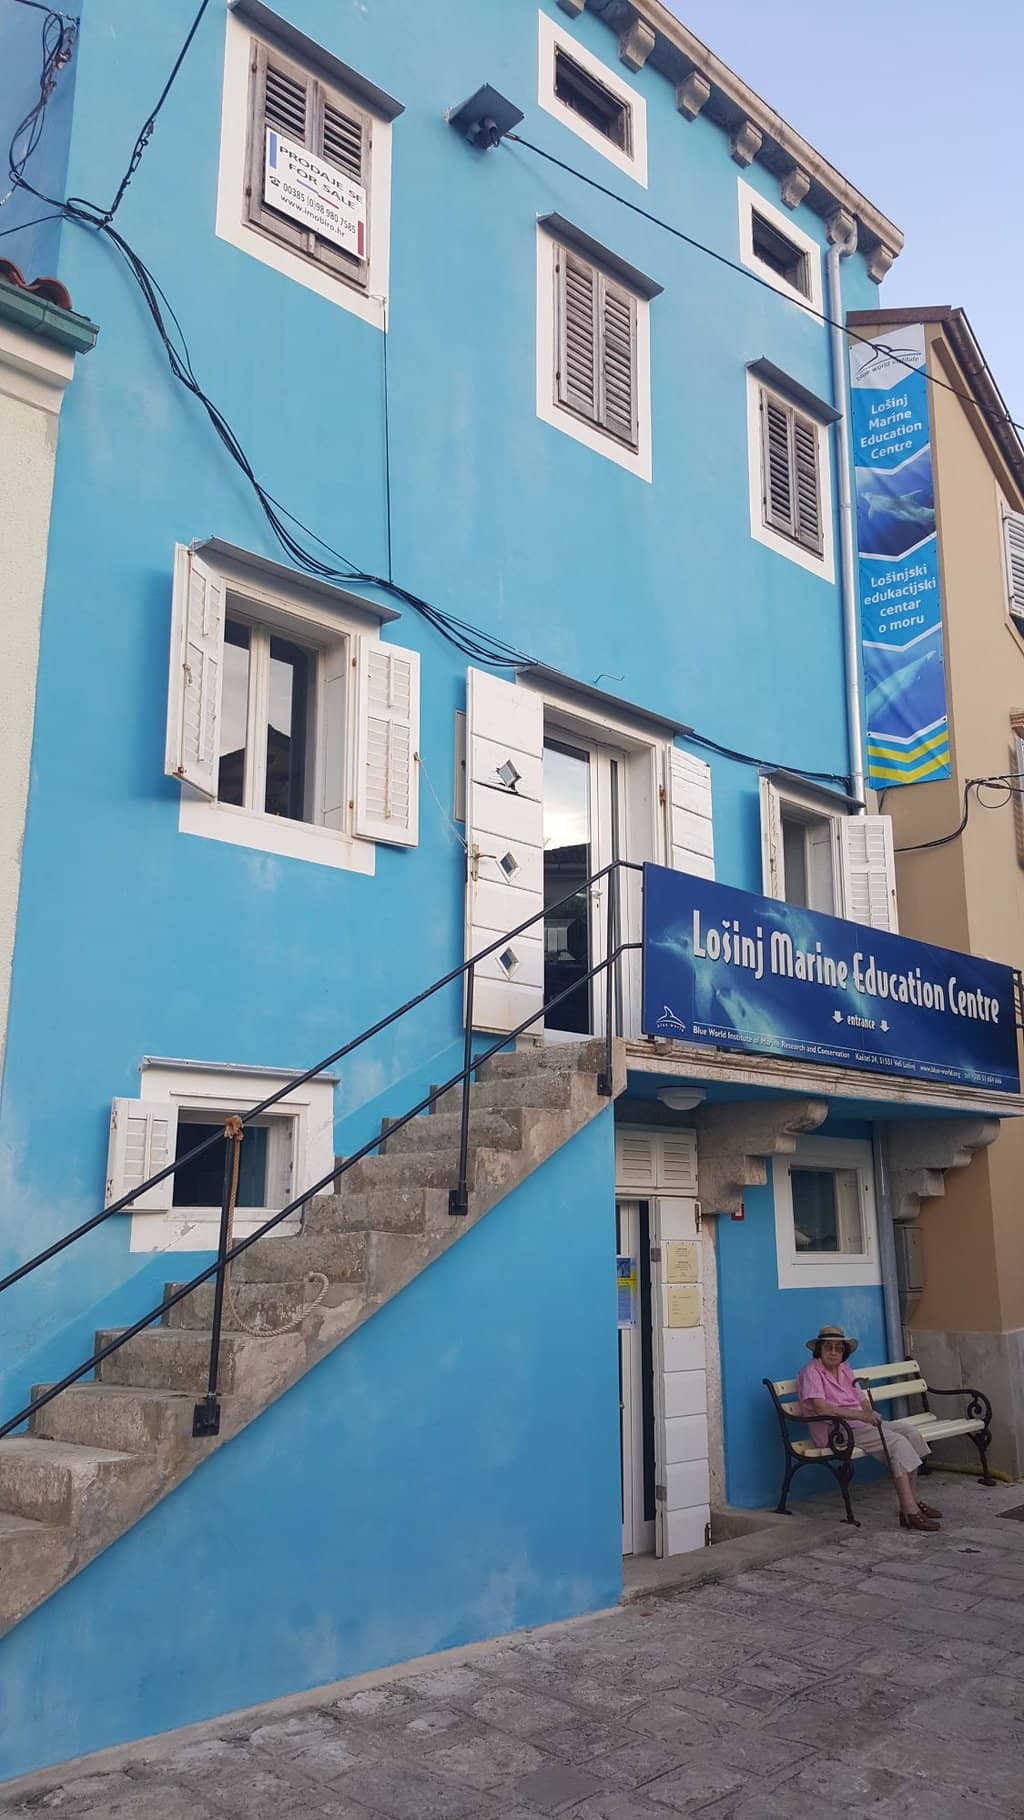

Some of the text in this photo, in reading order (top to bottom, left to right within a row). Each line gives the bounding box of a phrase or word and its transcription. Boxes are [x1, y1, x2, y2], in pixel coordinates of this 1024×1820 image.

[279, 145, 363, 204] PRODAJE SE
[283, 183, 306, 203] 00385
[288, 163, 355, 210] FOR SALE
[871, 394, 908, 415] Lošinj
[868, 410, 912, 430] Marine
[860, 422, 922, 448] Education
[871, 441, 912, 459] Centre
[871, 563, 928, 588] Lošinjski
[864, 577, 937, 605] edukacijski
[880, 599, 921, 617] centar
[878, 615, 924, 633] o moru
[692, 909, 1000, 1024] Lošinj Marine Education Centre
[847, 1014, 876, 1031] entrance
[693, 1025, 707, 1036] Blue
[708, 1028, 727, 1039] World
[727, 1031, 753, 1043] Institute
[760, 1036, 780, 1048] Marine
[781, 1040, 806, 1051] Research
[807, 1044, 817, 1053] and
[817, 1046, 850, 1059] Conservation
